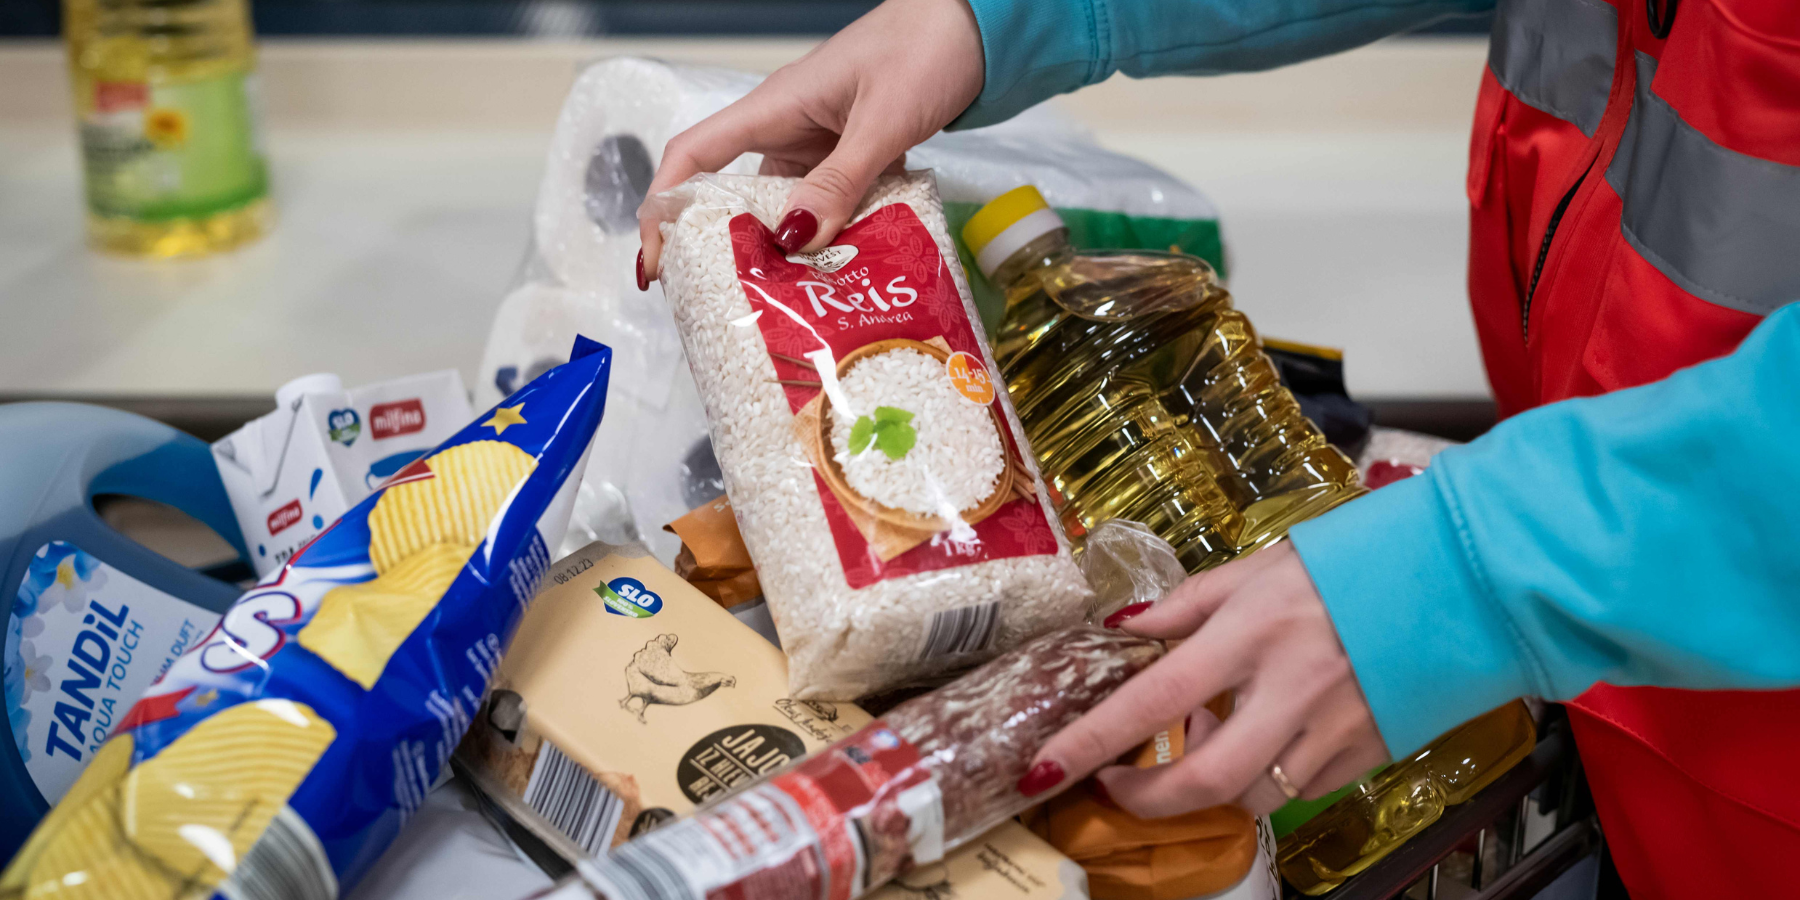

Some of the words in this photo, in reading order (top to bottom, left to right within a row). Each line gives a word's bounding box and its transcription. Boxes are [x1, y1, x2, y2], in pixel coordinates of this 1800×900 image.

[796, 276, 918, 317] Reis
[837, 316, 854, 331] S.
[859, 311, 914, 328] Andrea
[373, 408, 422, 433] milfina
[553, 558, 594, 585] 08.12.23
[618, 584, 655, 608] SLO
[170, 618, 195, 657] DUFT
[106, 619, 144, 692] TOUCH
